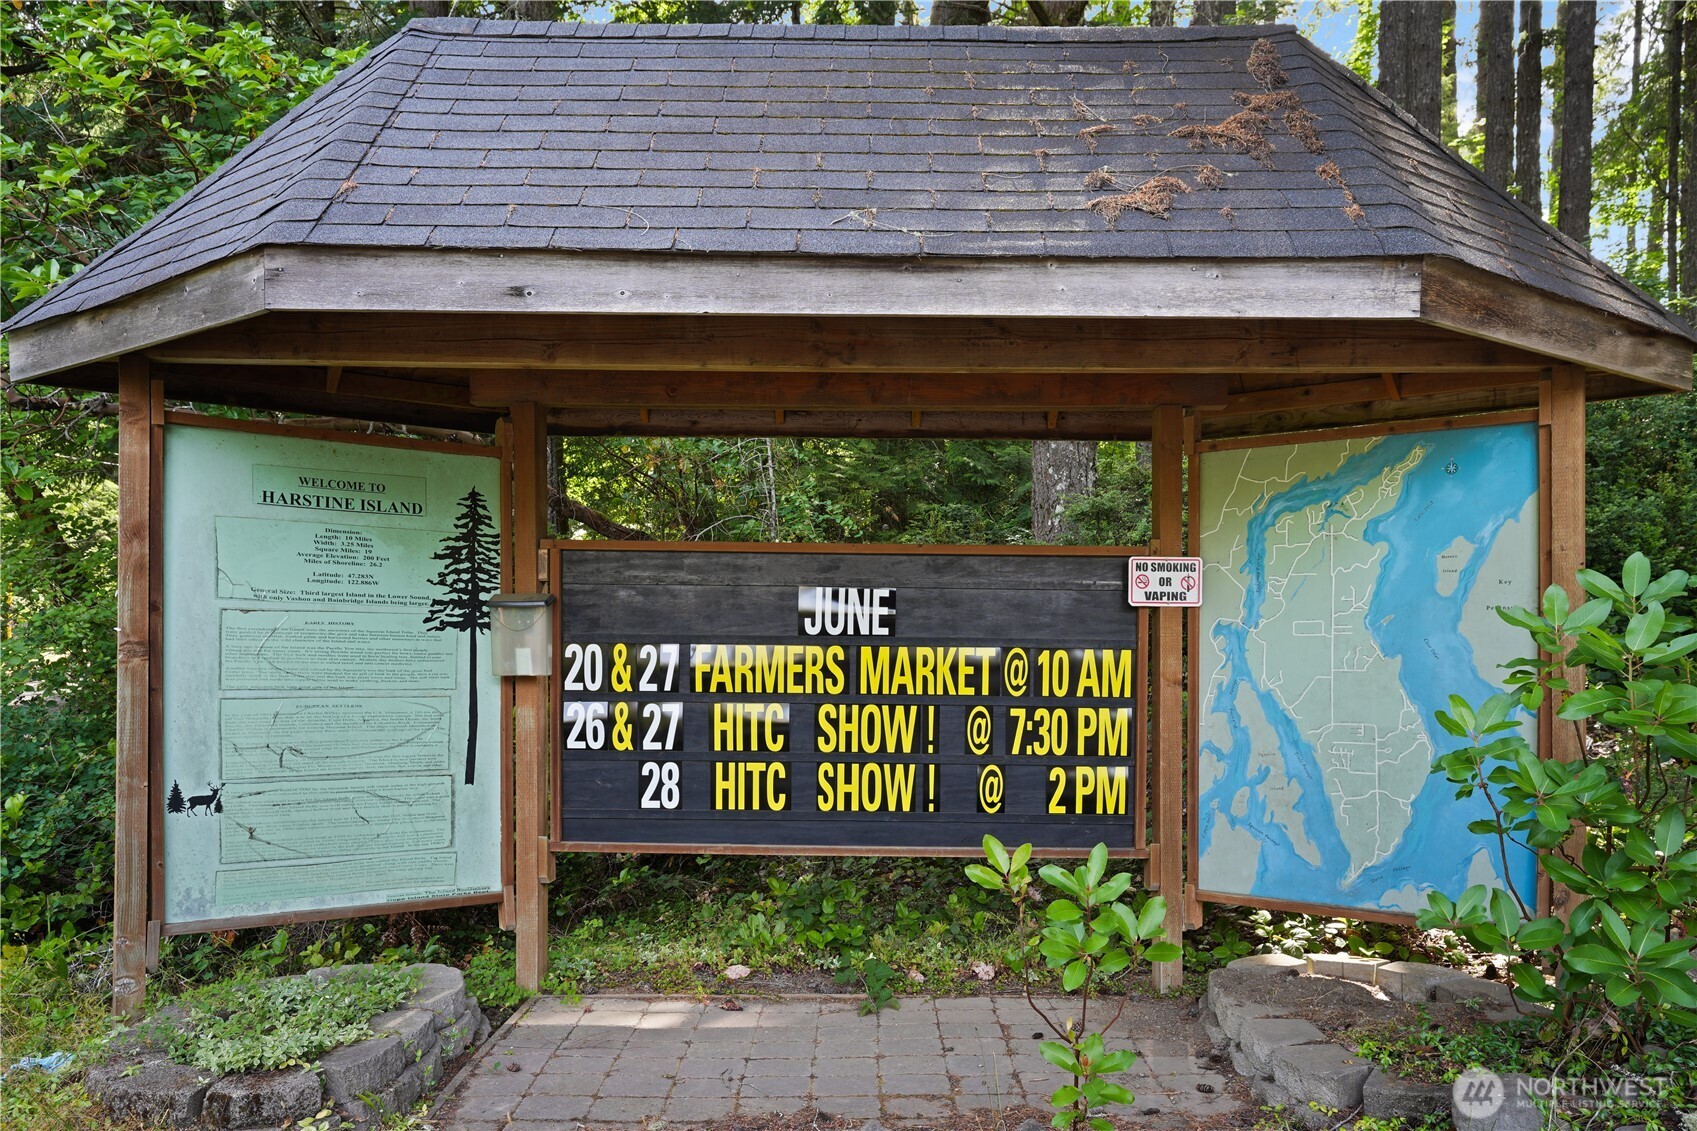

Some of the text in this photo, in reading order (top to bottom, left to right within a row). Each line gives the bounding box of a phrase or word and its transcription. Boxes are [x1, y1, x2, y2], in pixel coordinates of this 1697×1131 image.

[299, 477, 386, 493] WELCOME TO
[262, 490, 423, 515] HARSTINE ISLAND
[315, 546, 339, 554] Square
[1136, 562, 1197, 573] NO SMOKING
[1159, 577, 1172, 587] OR
[1144, 591, 1187, 601] VAPING
[804, 587, 889, 635] JUNE
[564, 643, 1132, 698] 20 & 27 FARMERS MARKET @ 10 AM
[566, 702, 606, 750] 26
[612, 702, 633, 751] &
[642, 702, 682, 751] 27
[714, 703, 784, 752] HITC
[967, 706, 992, 755] @
[1010, 708, 1069, 756] 7:30
[1077, 708, 1129, 756] PM
[640, 762, 679, 810] 28
[716, 762, 786, 812] HITC
[980, 764, 1004, 814] @
[1048, 767, 1067, 814] 2
[1076, 766, 1126, 815] PM
